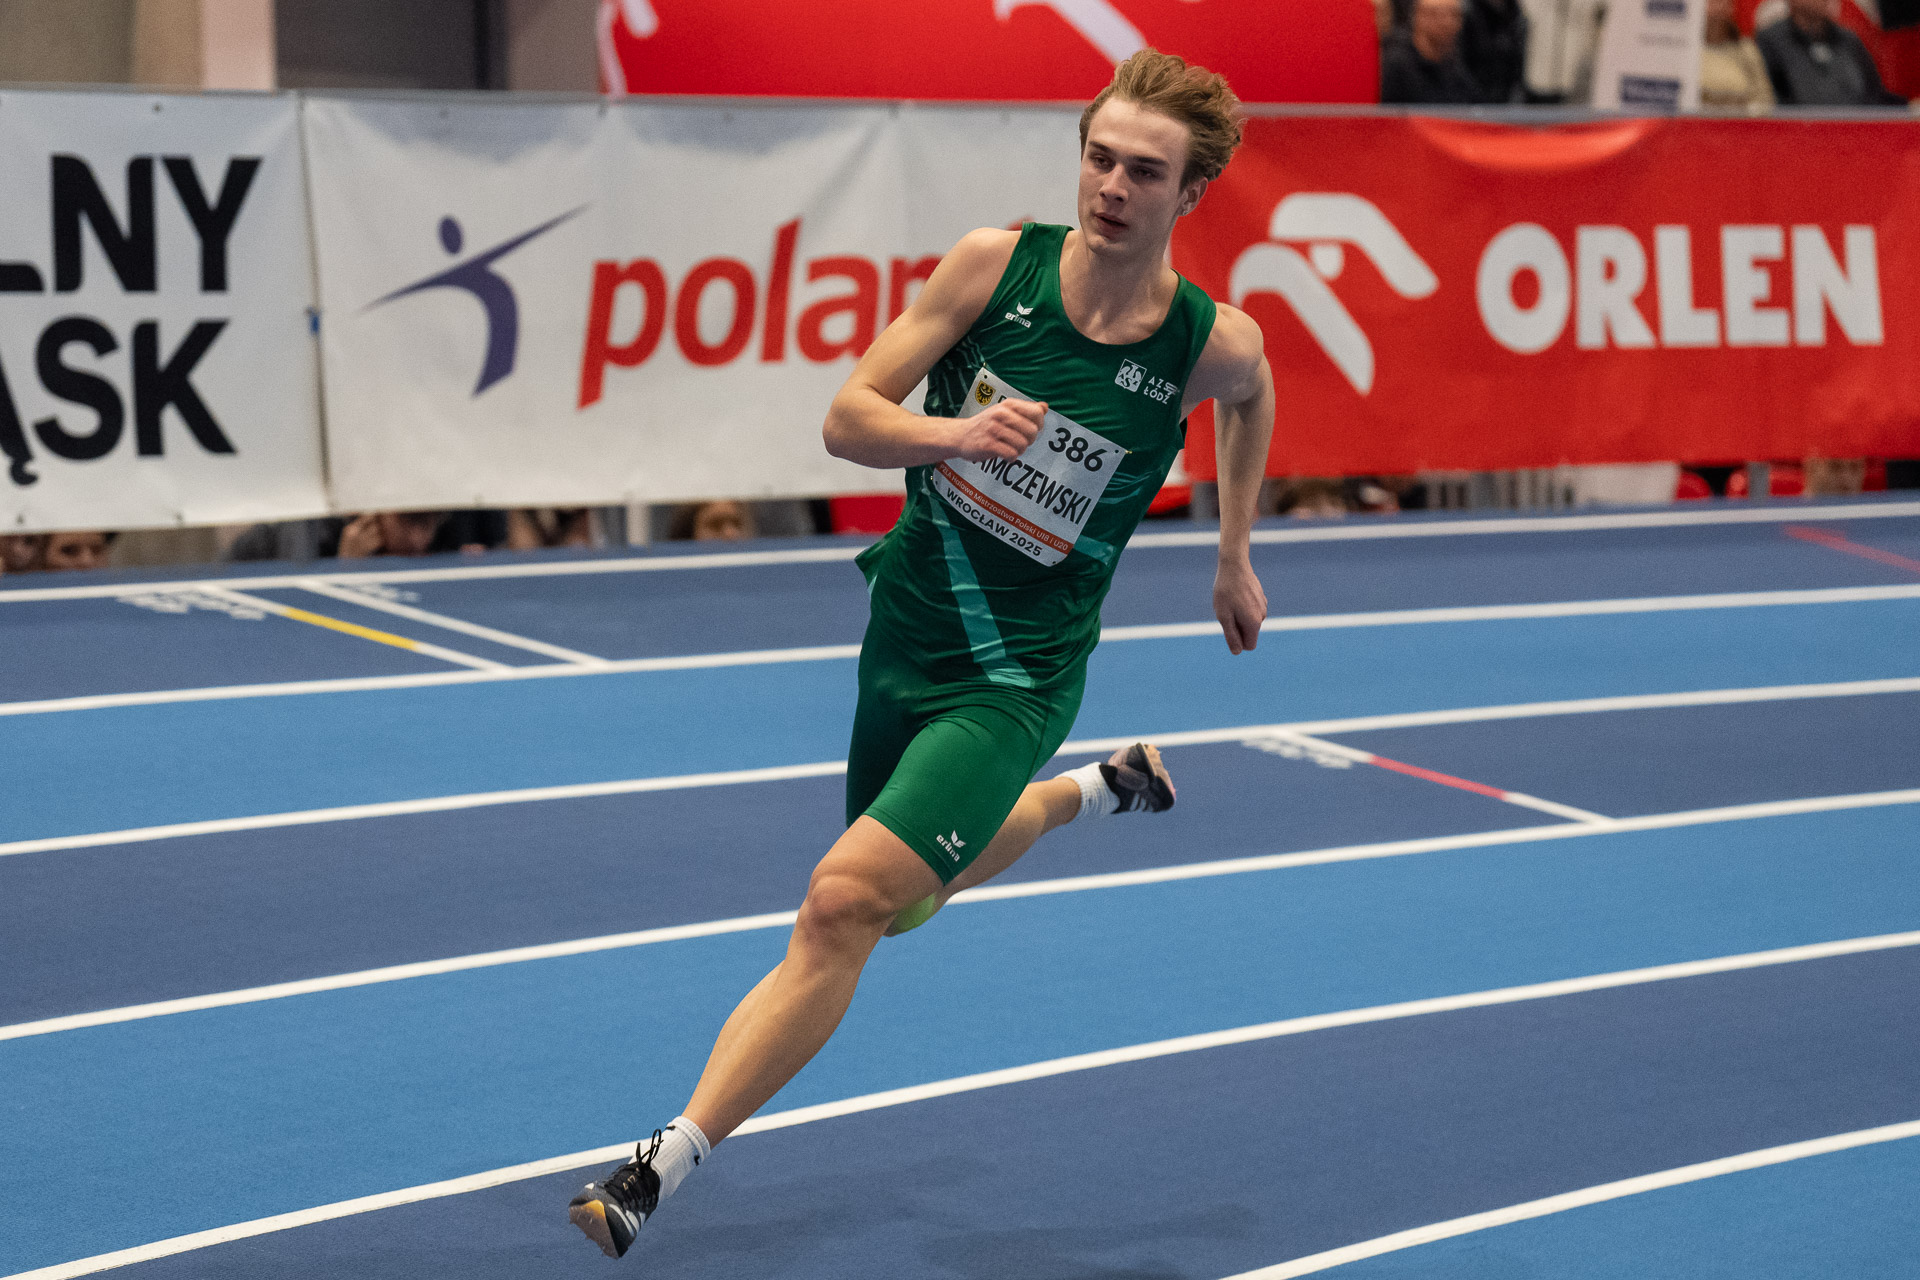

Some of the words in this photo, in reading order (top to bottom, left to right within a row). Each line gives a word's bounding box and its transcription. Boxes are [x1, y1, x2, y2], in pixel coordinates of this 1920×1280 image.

[0, 153, 263, 293] NY
[1005, 312, 1031, 328] erima
[1476, 222, 1884, 354] ORLEN
[0, 313, 238, 486] SK
[1143, 386, 1170, 404] ŁÓDŹ
[1048, 427, 1107, 472] 386
[947, 487, 1010, 537] WROCŁAW
[1009, 532, 1043, 556] 2025
[951, 476, 974, 497] Halowe
[973, 493, 1014, 522] Mistrzostwa
[1015, 518, 1036, 535] Polski
[1037, 530, 1050, 542] U18
[1053, 539, 1069, 551] U20
[936, 834, 960, 862] erima
